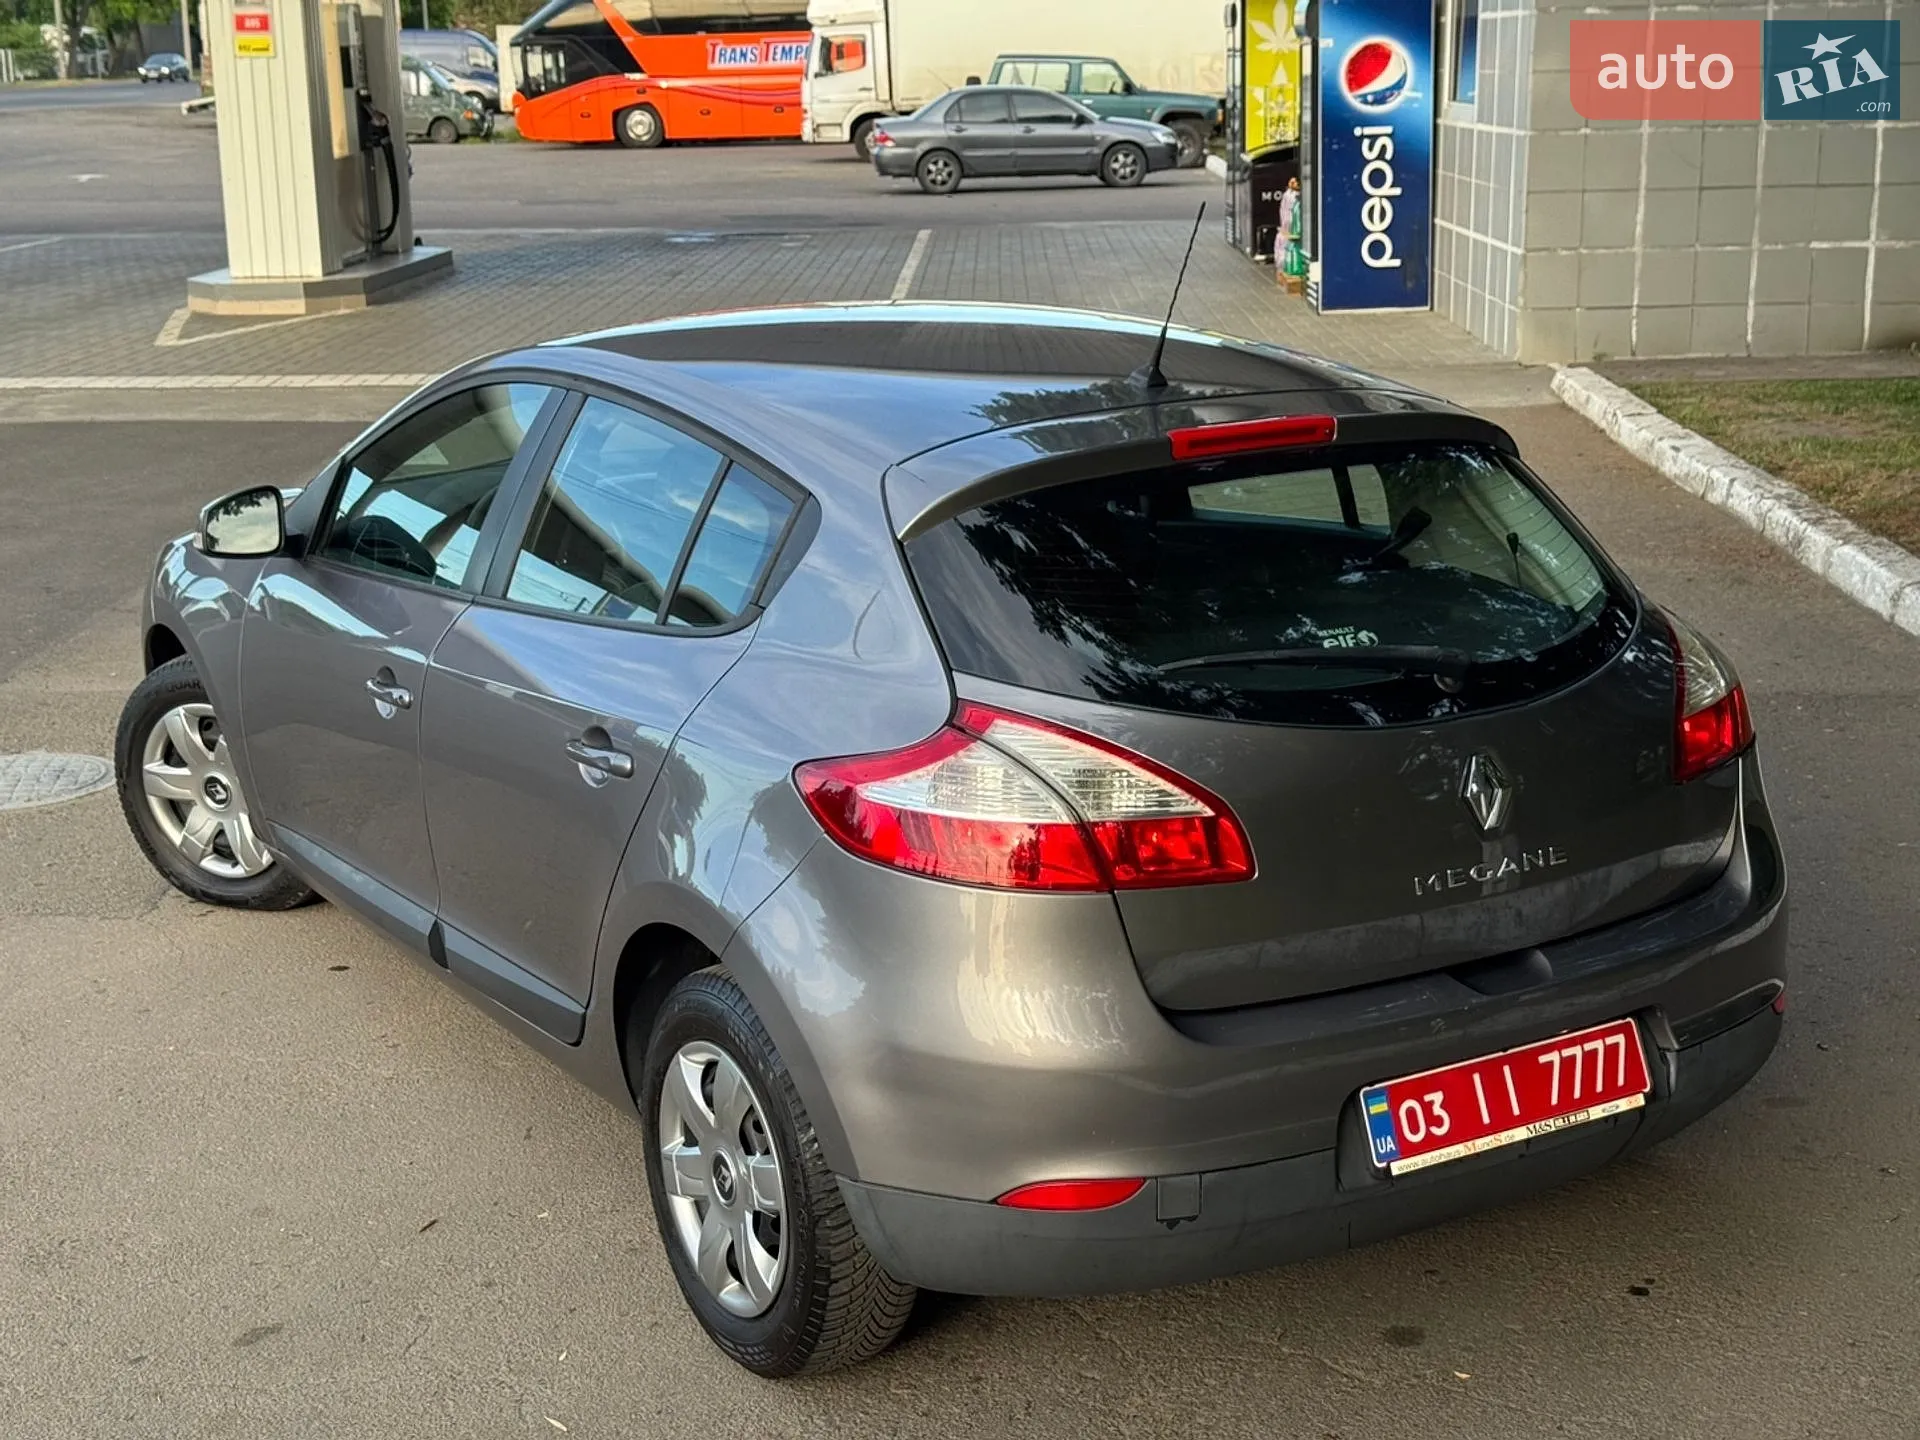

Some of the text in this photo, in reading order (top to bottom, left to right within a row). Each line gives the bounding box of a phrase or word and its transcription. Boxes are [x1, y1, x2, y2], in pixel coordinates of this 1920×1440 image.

[710, 43, 758, 64] TRANS
[1353, 125, 1402, 268] pepsi
[1414, 846, 1568, 895] MEGANE
[1398, 1090, 1451, 1143] 03
[1538, 1033, 1626, 1106] 7777
[1376, 1136, 1396, 1153] UA
